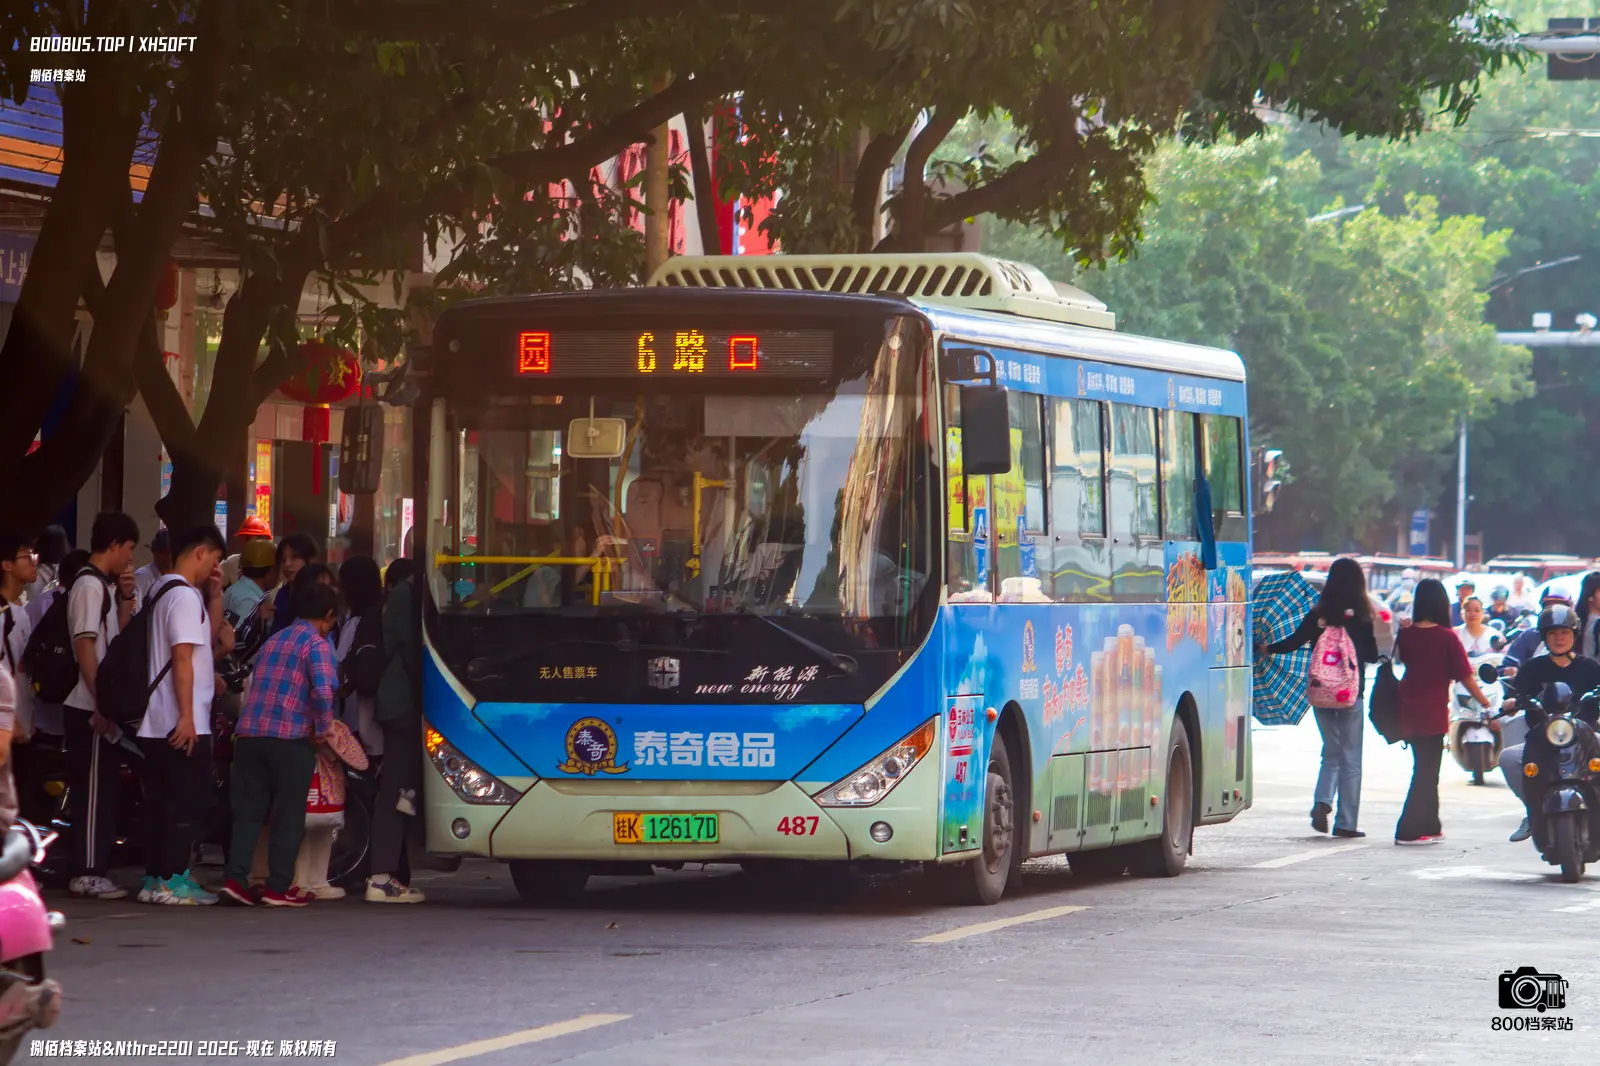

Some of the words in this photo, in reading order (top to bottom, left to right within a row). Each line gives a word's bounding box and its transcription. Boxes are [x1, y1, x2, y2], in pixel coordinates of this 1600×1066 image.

[519, 332, 550, 373] 园
[728, 336, 758, 371] 口
[539, 665, 598, 679] 无人售票车
[743, 664, 820, 684] 新能源
[694, 682, 736, 695] new
[740, 682, 807, 701] energy
[574, 728, 608, 762] 泰奇
[633, 730, 776, 768] 泰奇食品
[649, 816, 717, 840] 12617D
[777, 815, 820, 836] 487
